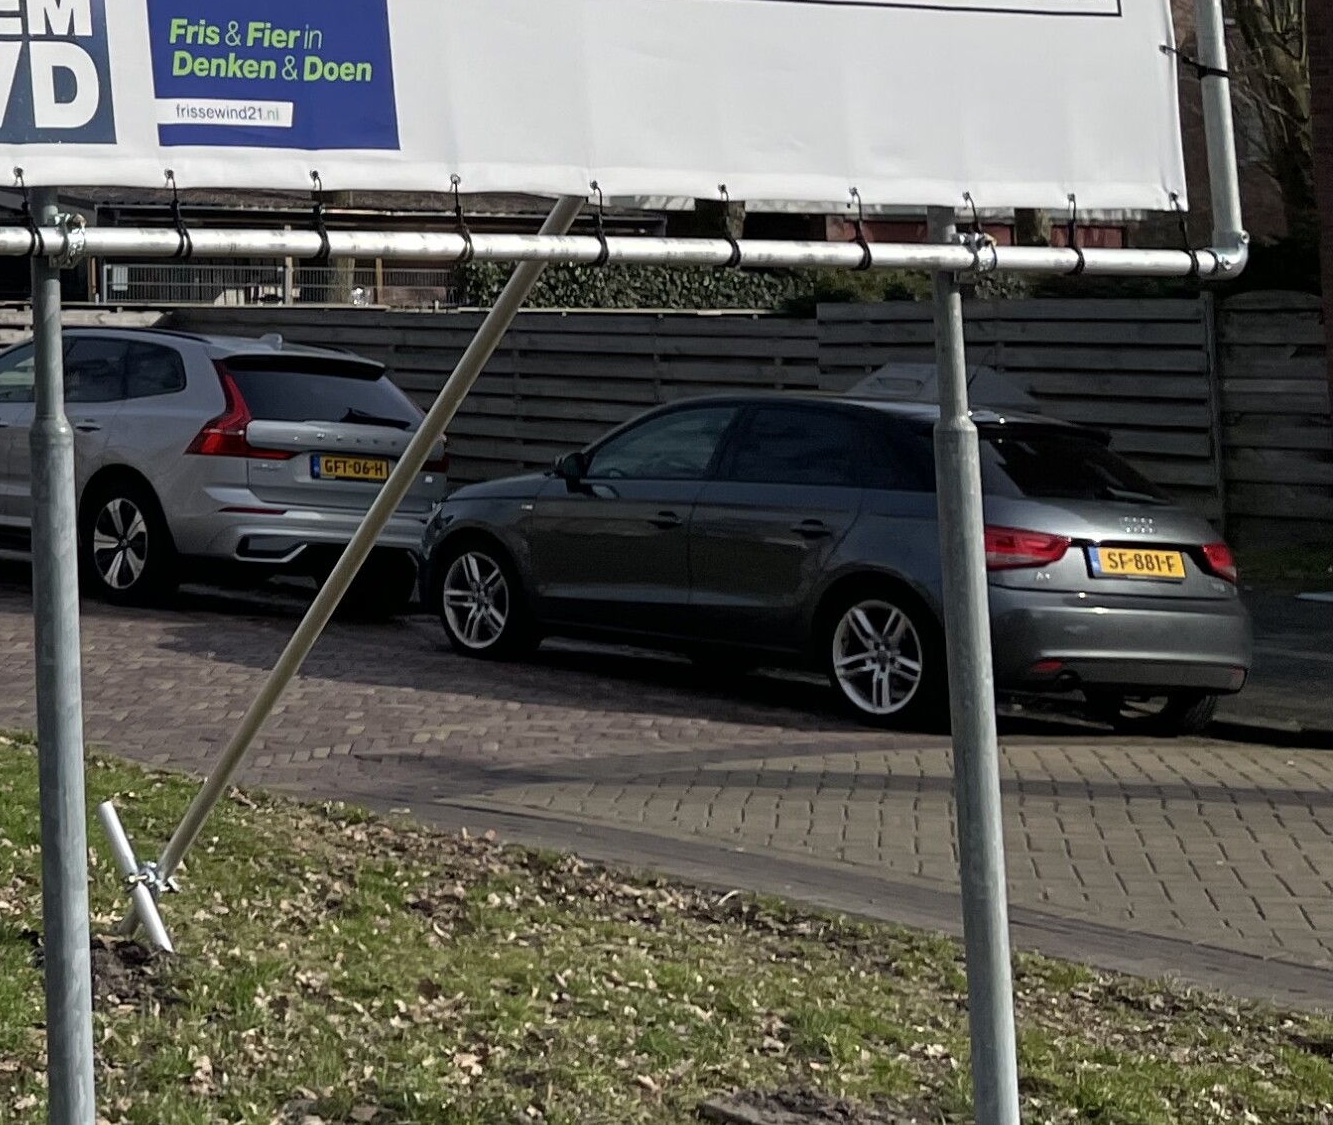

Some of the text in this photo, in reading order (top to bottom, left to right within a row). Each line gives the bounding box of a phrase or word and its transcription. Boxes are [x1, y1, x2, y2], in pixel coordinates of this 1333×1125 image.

[169, 18, 323, 50] Fris & Fier in
[172, 51, 372, 82] Denken & Doen
[176, 103, 279, 122] frissewind21.nl
[325, 459, 383, 476] GFT-06-H
[1107, 552, 1174, 572] SF-881-F
